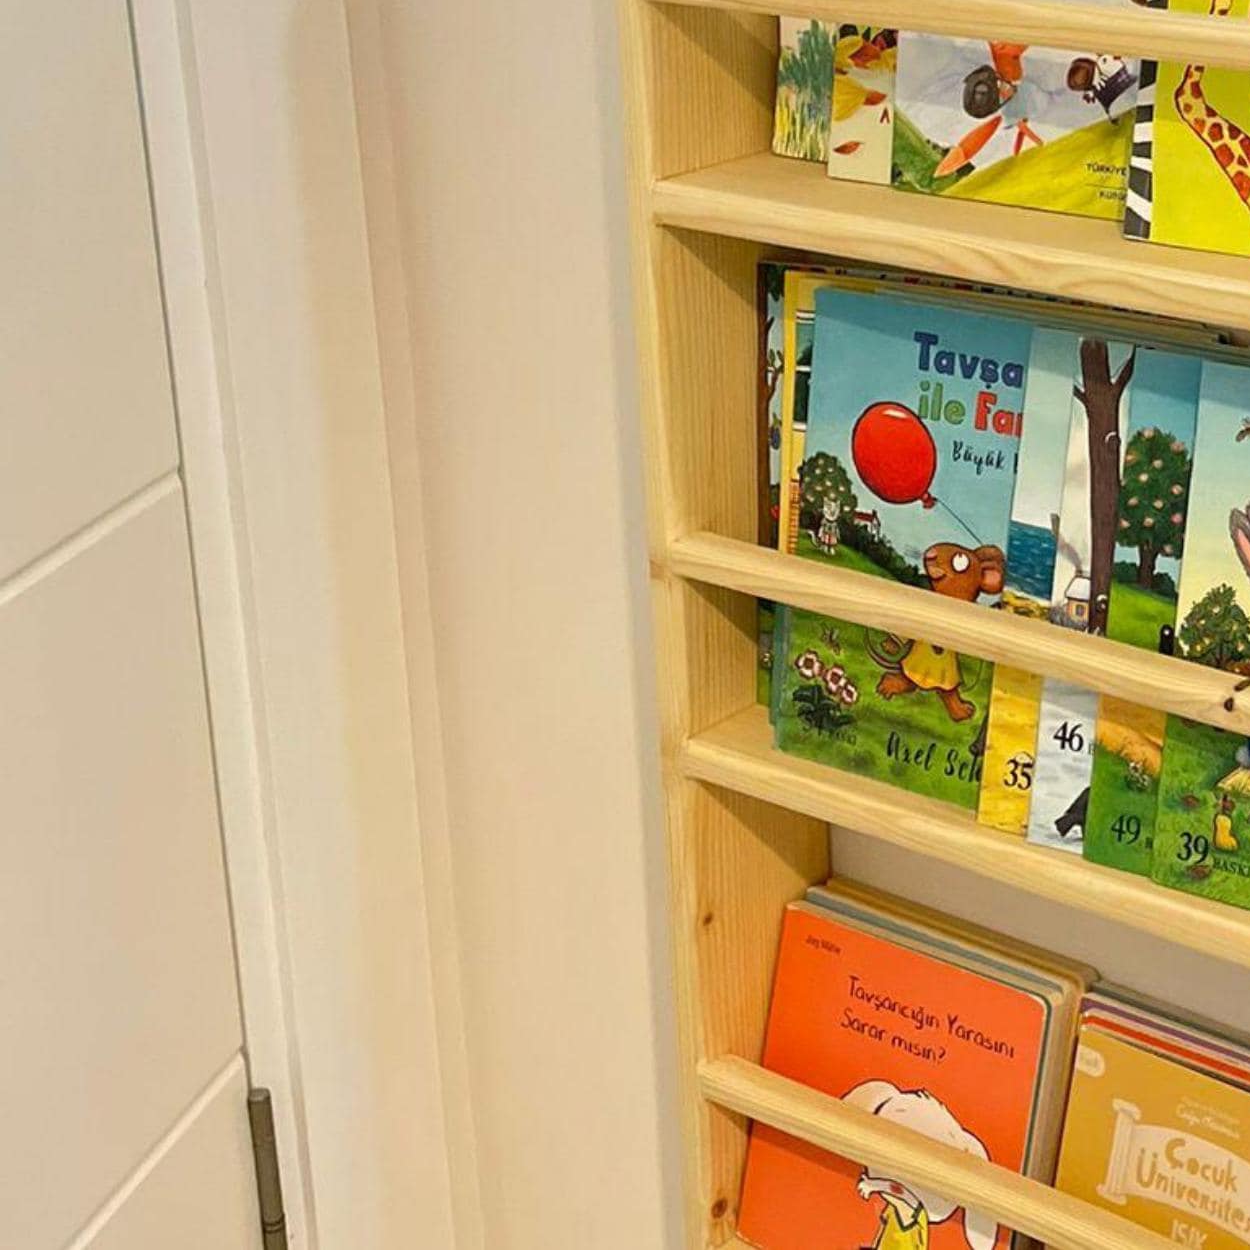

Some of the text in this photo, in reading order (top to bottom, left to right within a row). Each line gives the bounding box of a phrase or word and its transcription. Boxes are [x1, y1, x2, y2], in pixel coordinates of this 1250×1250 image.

[914, 331, 1024, 390] Tavşa
[918, 380, 966, 425] ile
[886, 731, 937, 772] Axel
[1053, 721, 1084, 752] 46
[1003, 758, 1035, 791] 35
[1111, 814, 1141, 845] 49
[1176, 831, 1209, 865] 39
[1212, 856, 1250, 877] BASKI
[840, 1007, 886, 1042] Sarar
[849, 975, 1015, 1058] Tavşancığın Yarasını
[1165, 1137, 1238, 1193] Çocuk
